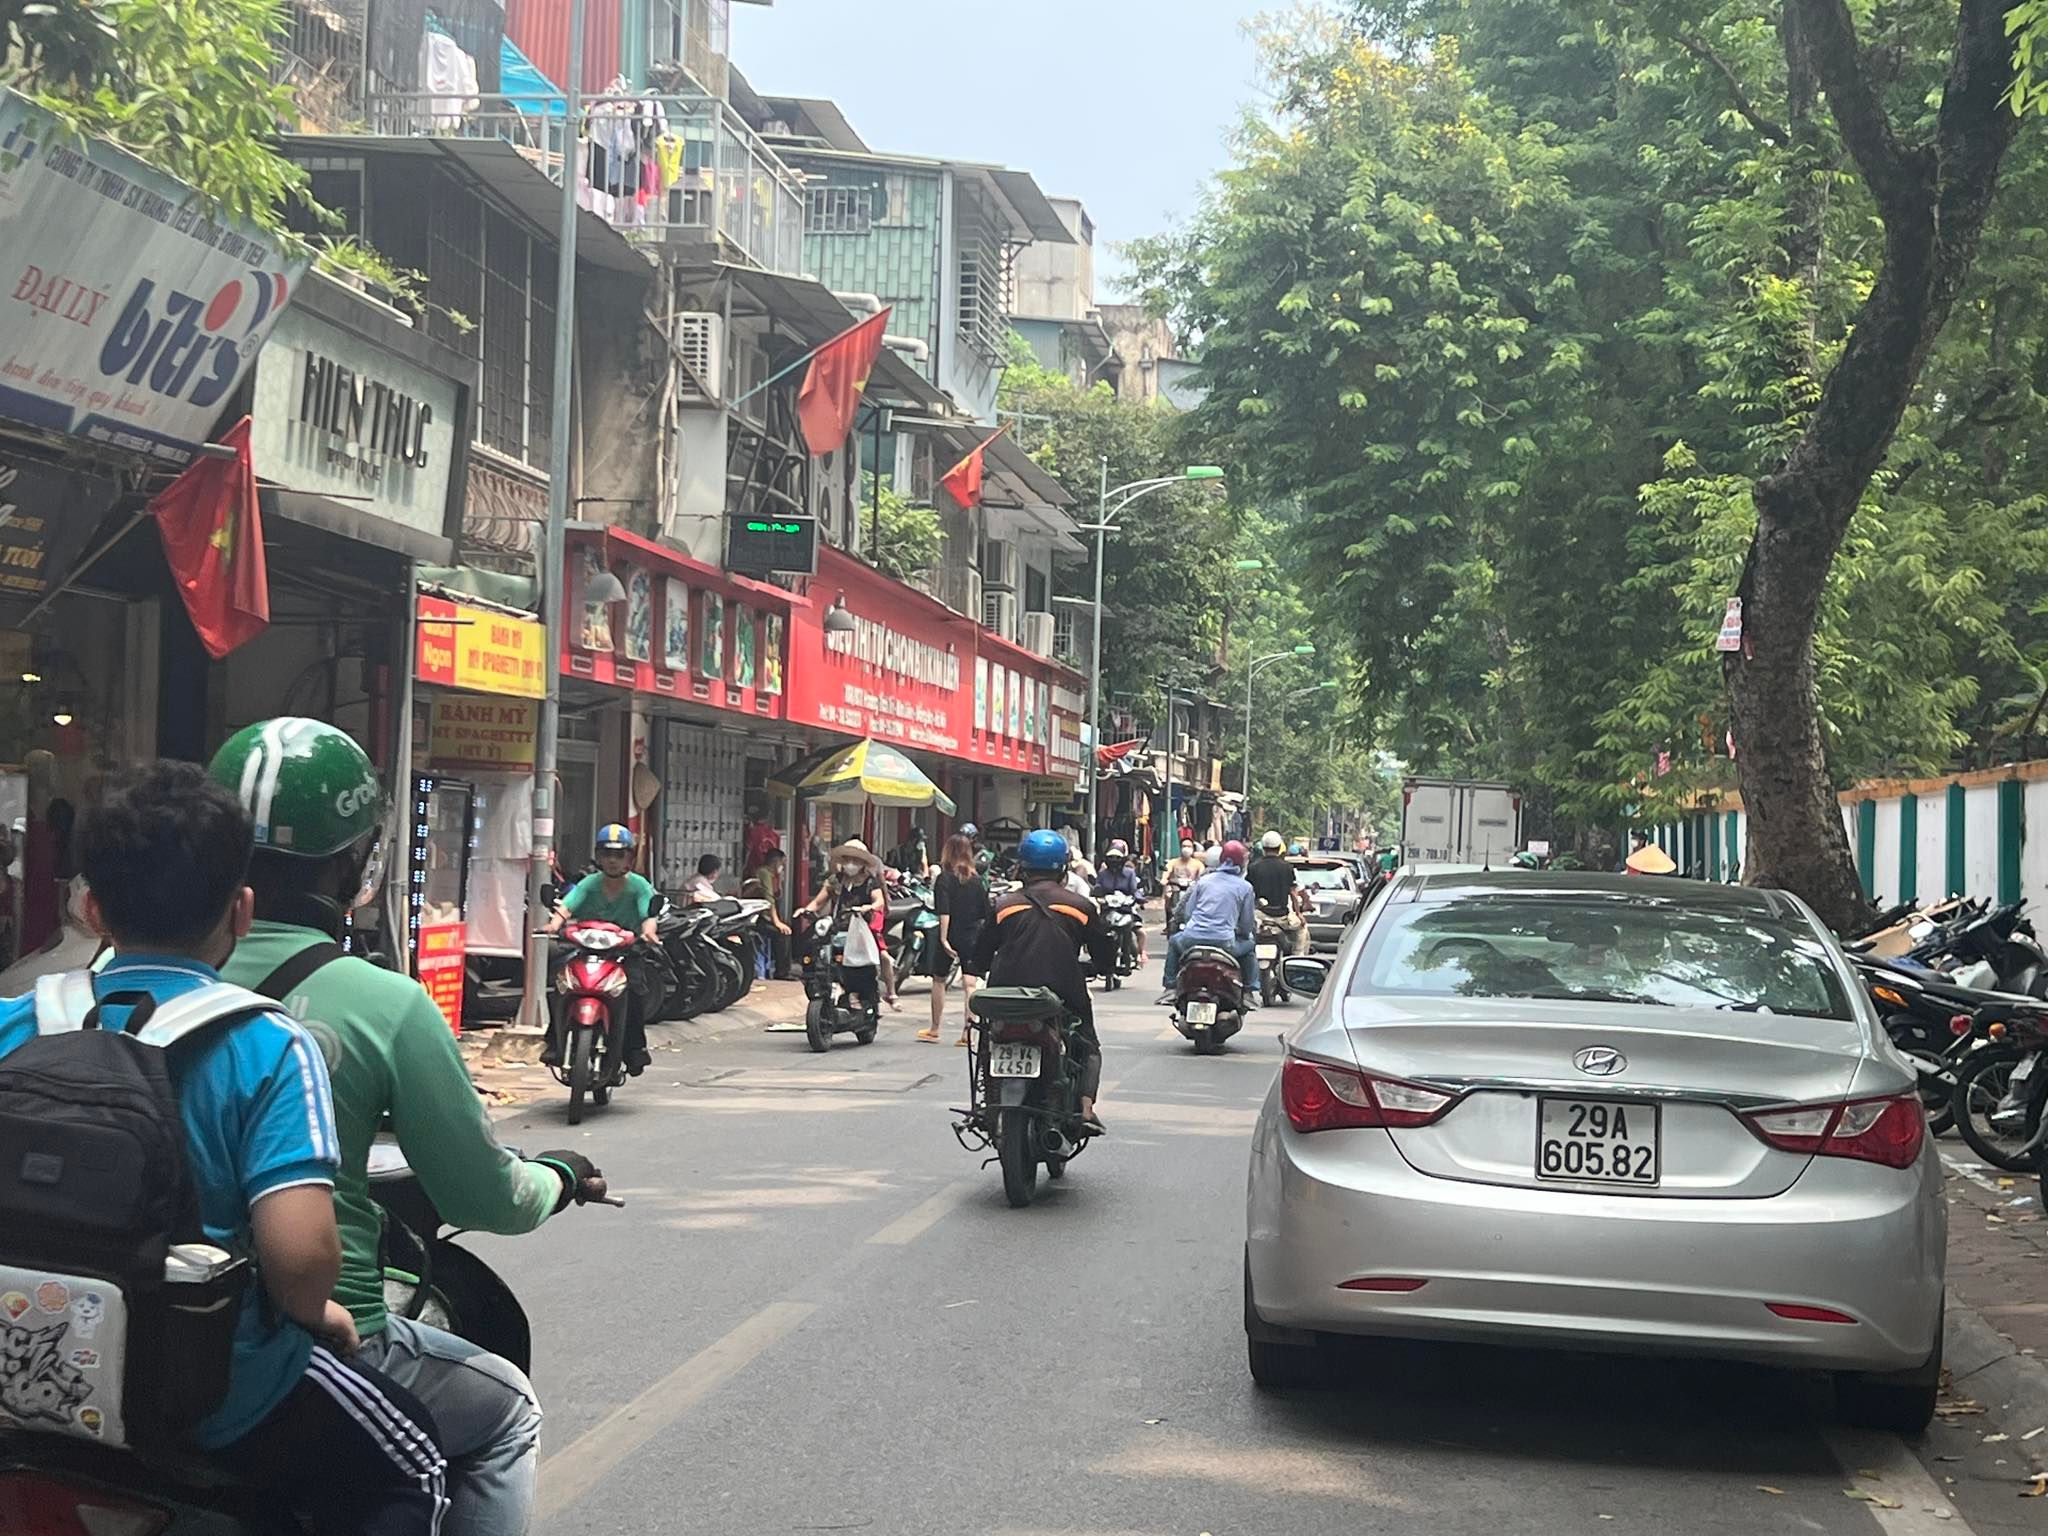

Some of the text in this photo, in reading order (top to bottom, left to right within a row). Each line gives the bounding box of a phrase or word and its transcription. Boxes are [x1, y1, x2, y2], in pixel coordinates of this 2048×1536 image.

[12, 264, 110, 327] ĐẠI LÝ
[1568, 1104, 1628, 1140] 29A
[1543, 1140, 1653, 1179] 605.82
